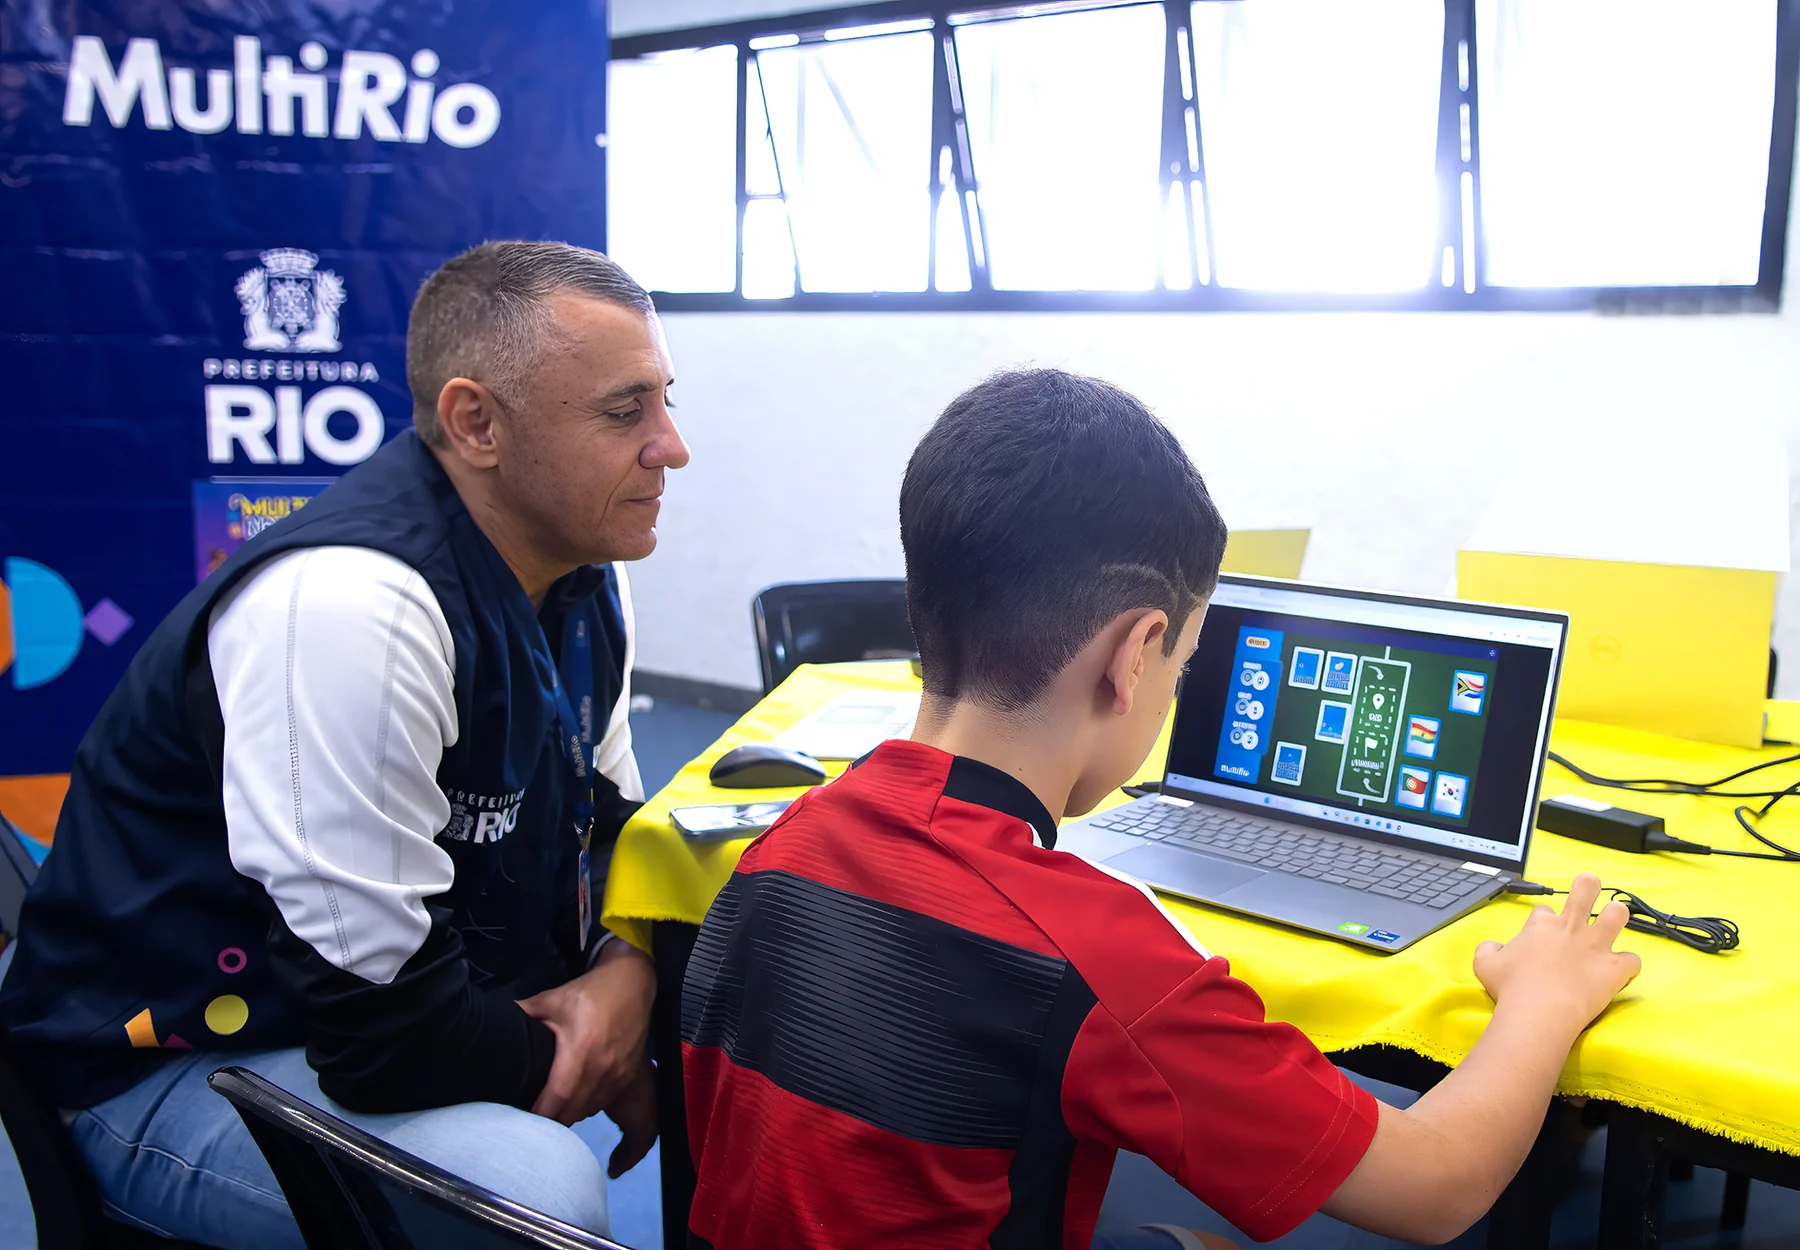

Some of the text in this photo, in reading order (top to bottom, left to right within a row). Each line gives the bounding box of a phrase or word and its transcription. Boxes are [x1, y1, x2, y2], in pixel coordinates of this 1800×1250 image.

[62, 34, 502, 149] MultiRio
[203, 358, 379, 383] PREFEITURA
[204, 384, 385, 466] RIO
[473, 802, 521, 844] RIO
